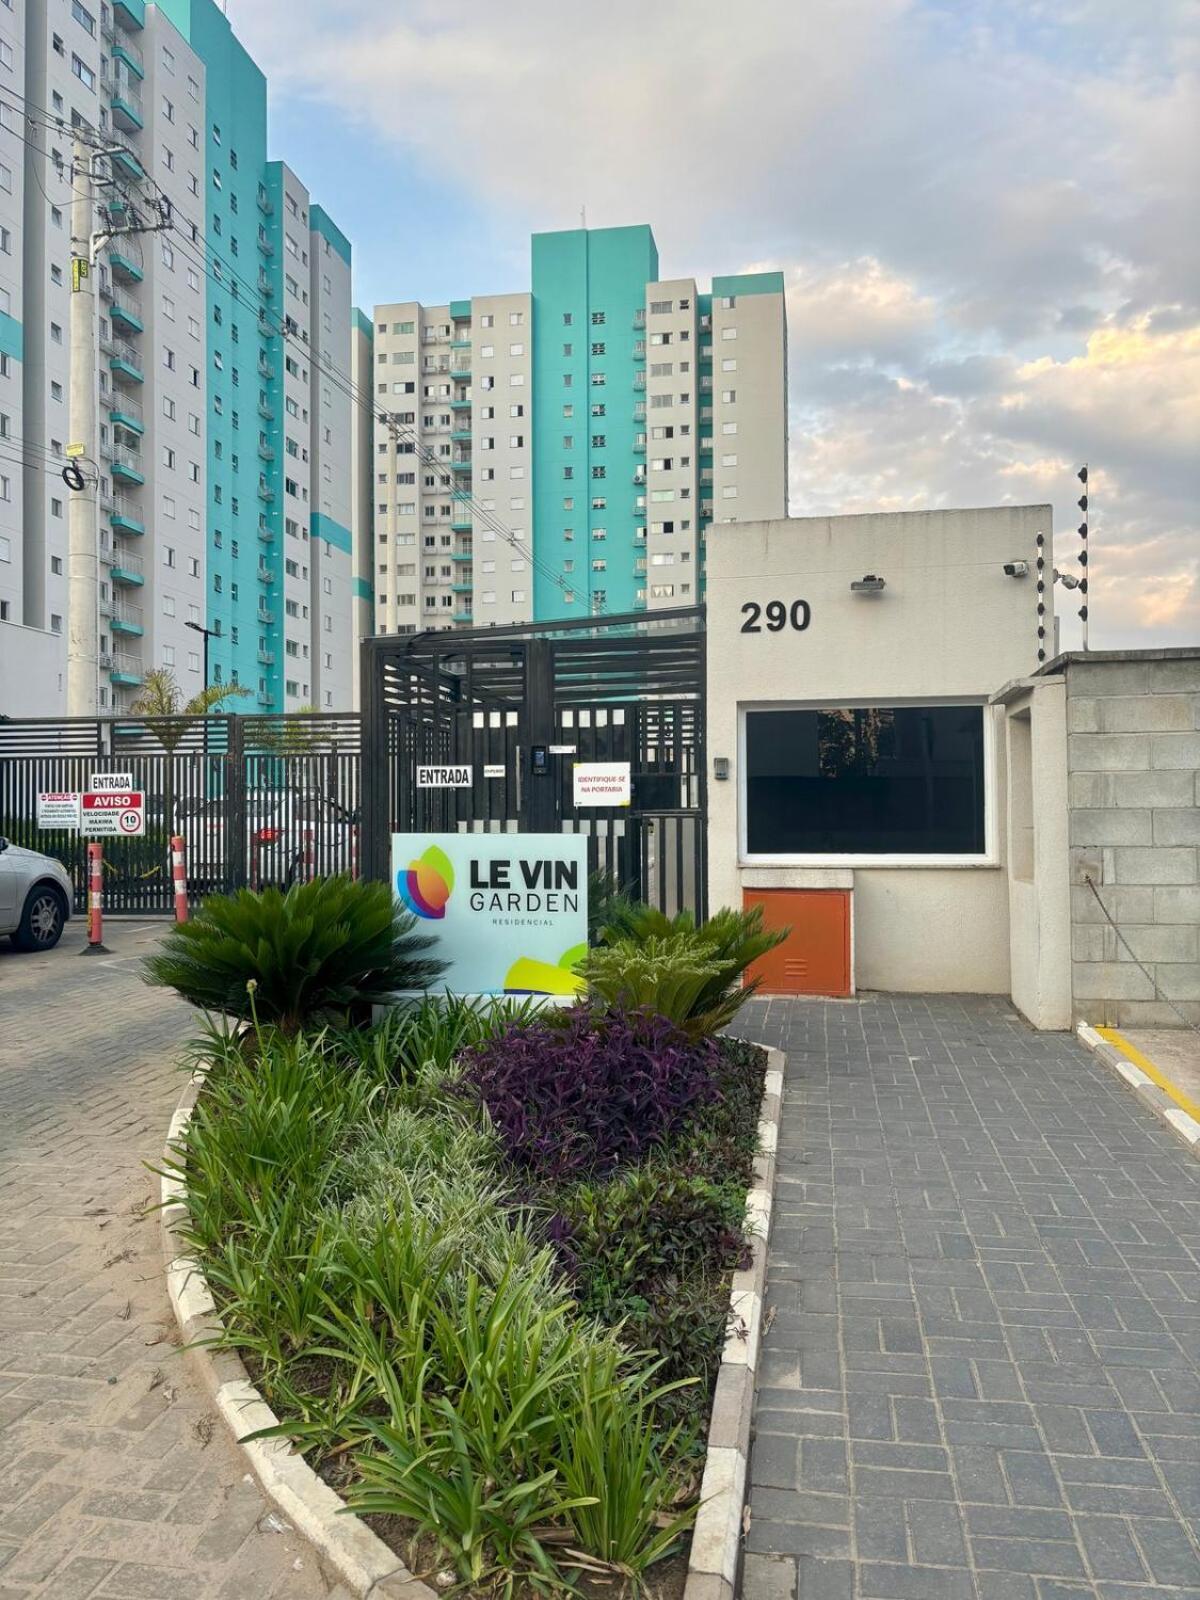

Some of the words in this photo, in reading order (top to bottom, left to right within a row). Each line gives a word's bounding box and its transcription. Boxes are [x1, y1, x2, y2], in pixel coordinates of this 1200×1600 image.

[740, 599, 811, 633] 290
[93, 776, 130, 789] ENTRADA
[420, 769, 469, 784] ENTRADA
[93, 796, 131, 807] AVISO
[124, 815, 137, 824] 10
[470, 859, 511, 889] LE
[519, 859, 578, 889] VIN
[470, 892, 578, 912] GARDEN
